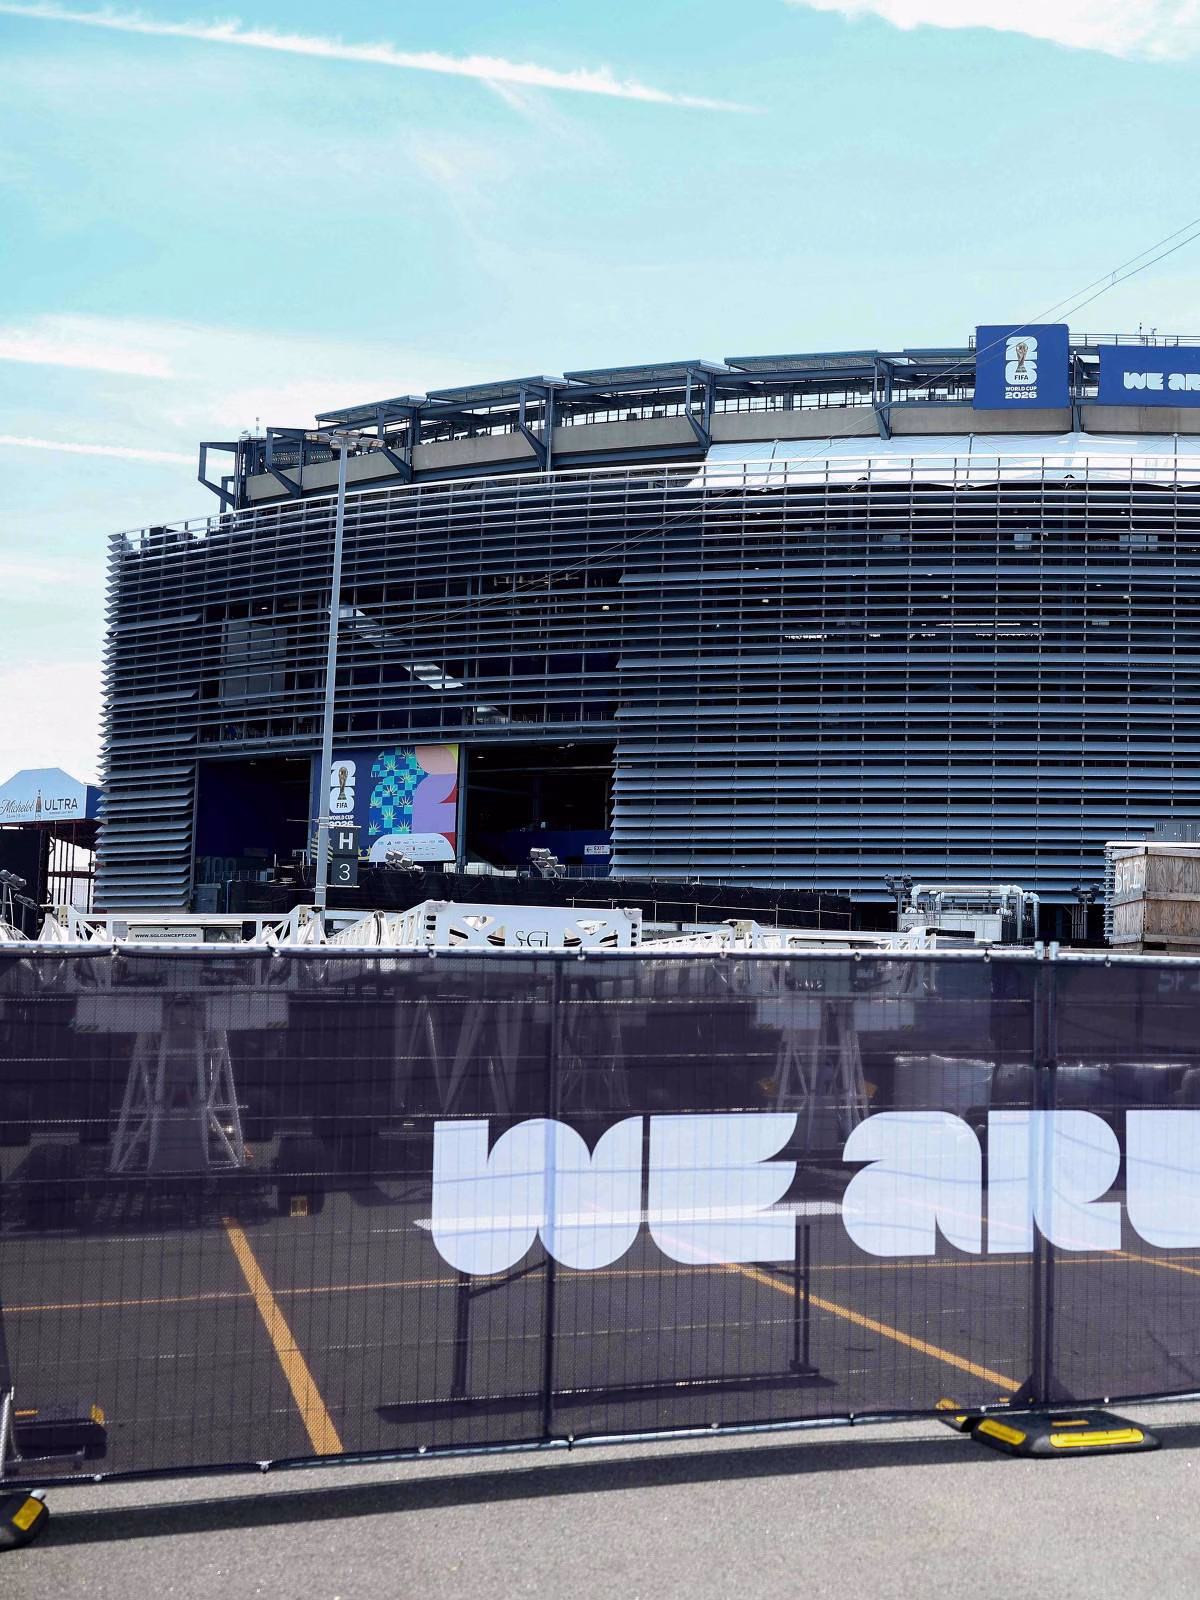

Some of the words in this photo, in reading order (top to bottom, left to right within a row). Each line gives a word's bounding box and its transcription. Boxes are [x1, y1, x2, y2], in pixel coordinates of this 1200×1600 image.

[1123, 372, 1164, 390] WE
[44, 798, 78, 811] ULTRA
[338, 832, 353, 850] H
[338, 863, 351, 881] 3
[431, 1111, 800, 1275] WE
